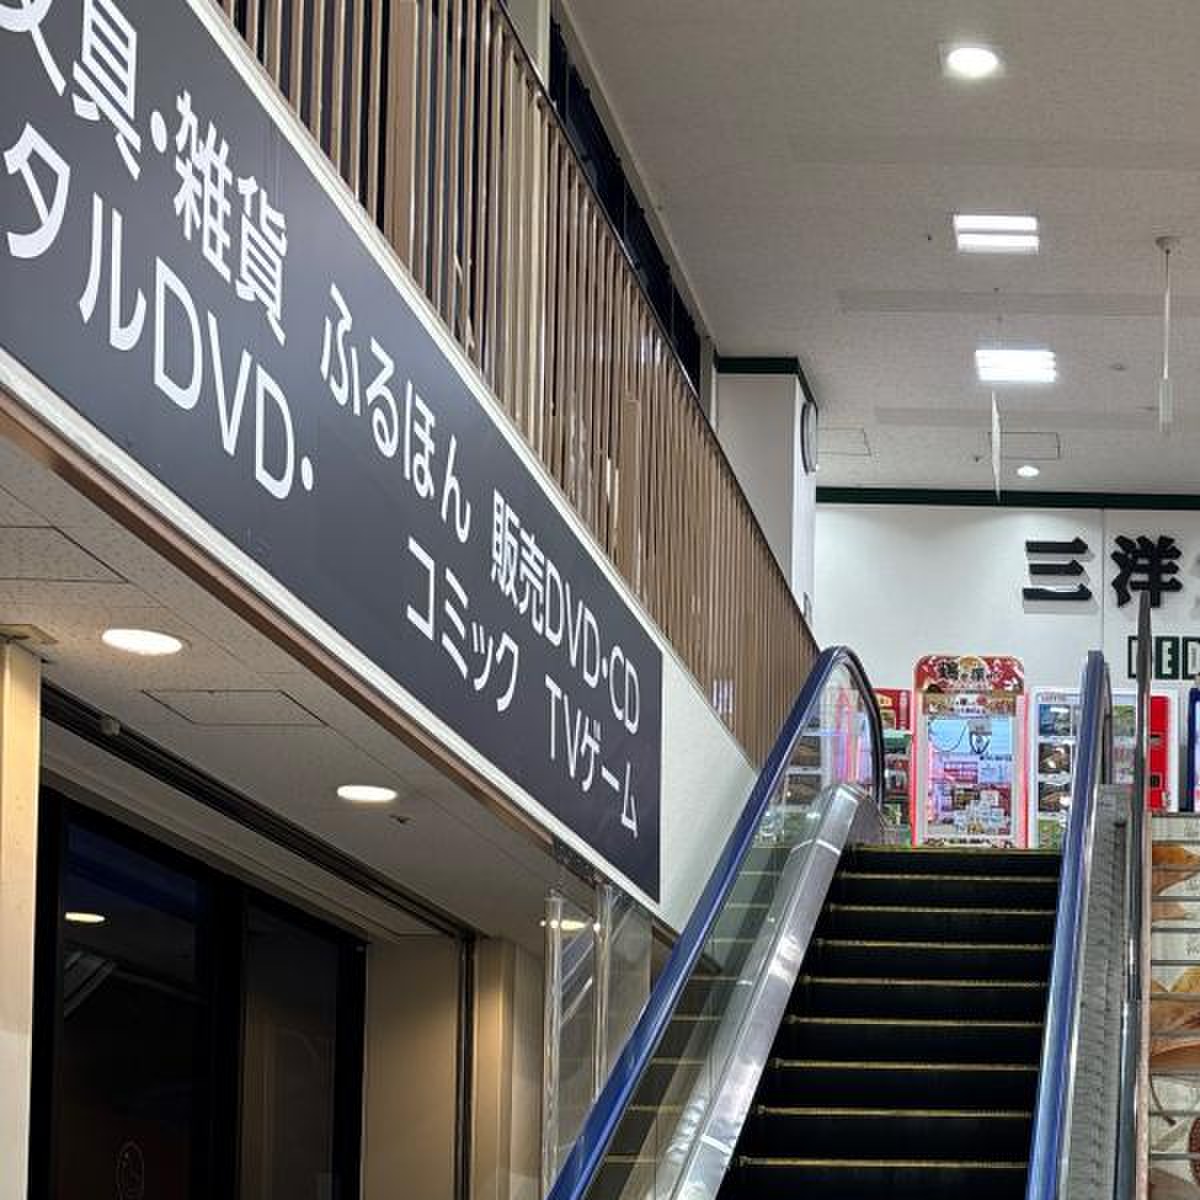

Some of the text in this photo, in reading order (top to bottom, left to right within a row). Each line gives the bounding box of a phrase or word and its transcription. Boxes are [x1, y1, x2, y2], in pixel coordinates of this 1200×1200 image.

[320, 284, 471, 543] ふるほん
[491, 488, 640, 736] 販売DVD・CD
[407, 537, 519, 713] コミック
[545, 674, 640, 840] TVゲーム
